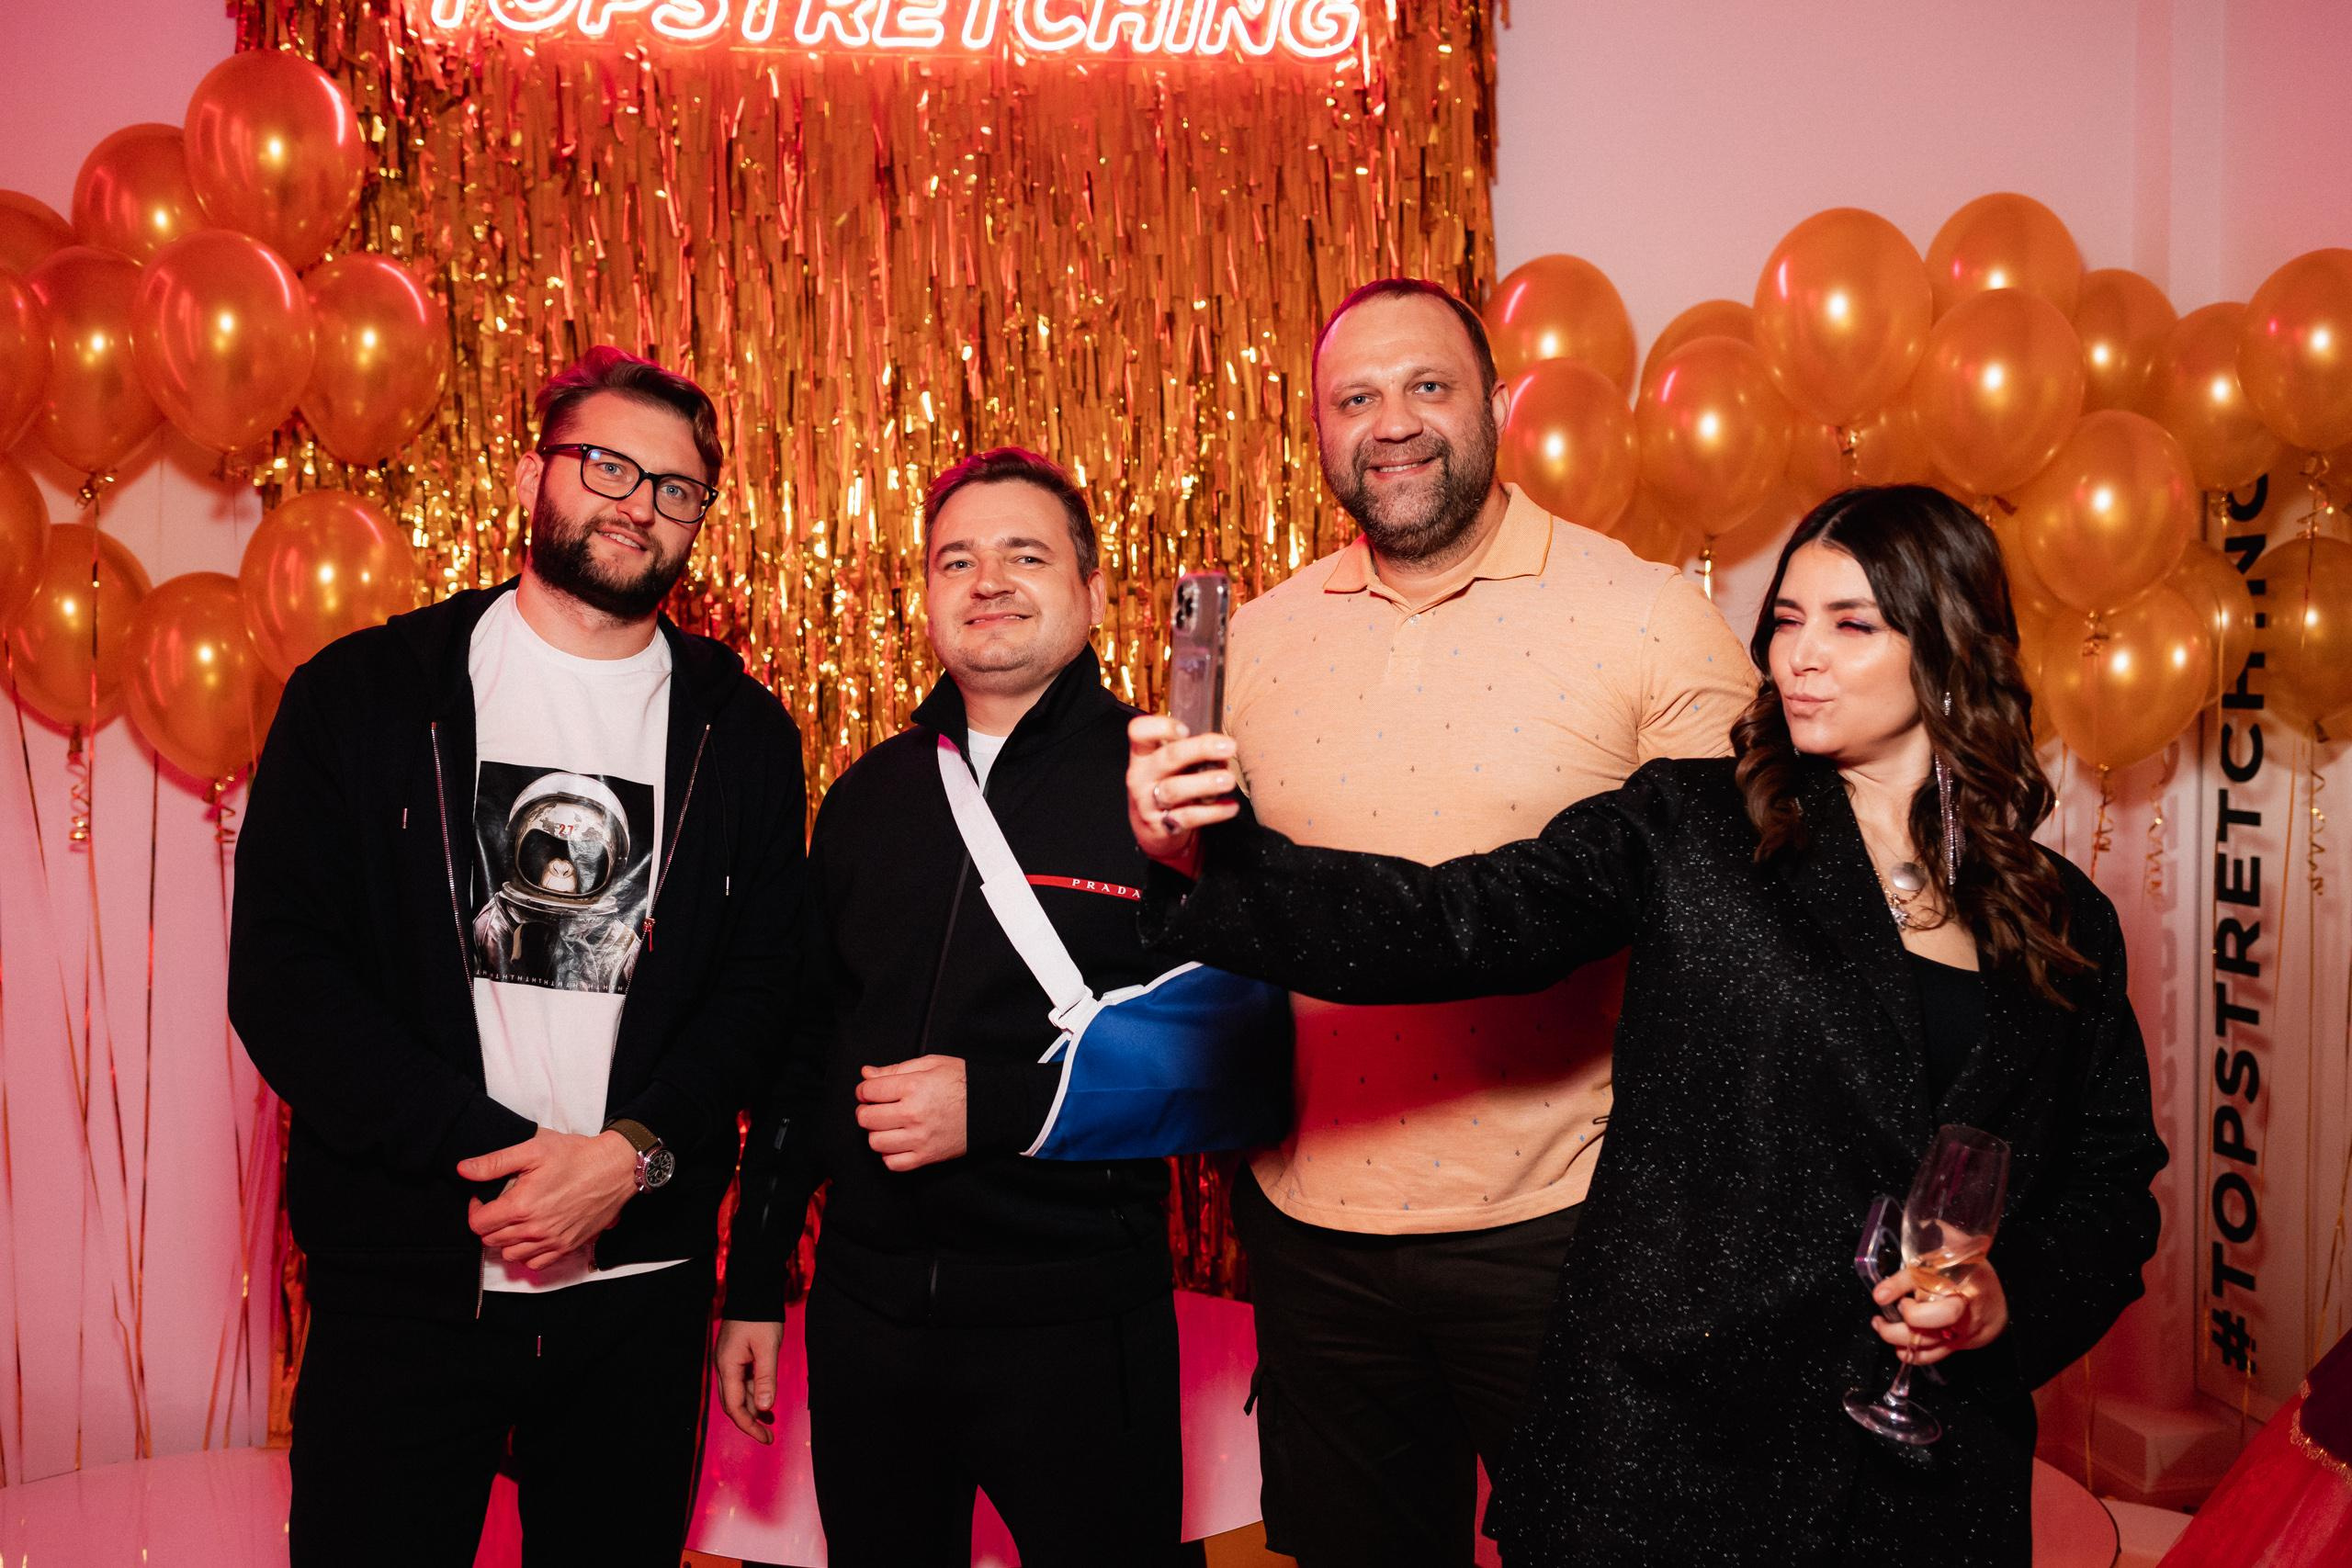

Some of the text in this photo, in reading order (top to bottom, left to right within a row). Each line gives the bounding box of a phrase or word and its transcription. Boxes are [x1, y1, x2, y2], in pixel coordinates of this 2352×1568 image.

[559, 823, 574, 837] 27
[1071, 878, 1141, 898] PRADA
[2211, 473, 2268, 1374] #TOPSTRETCHNG
